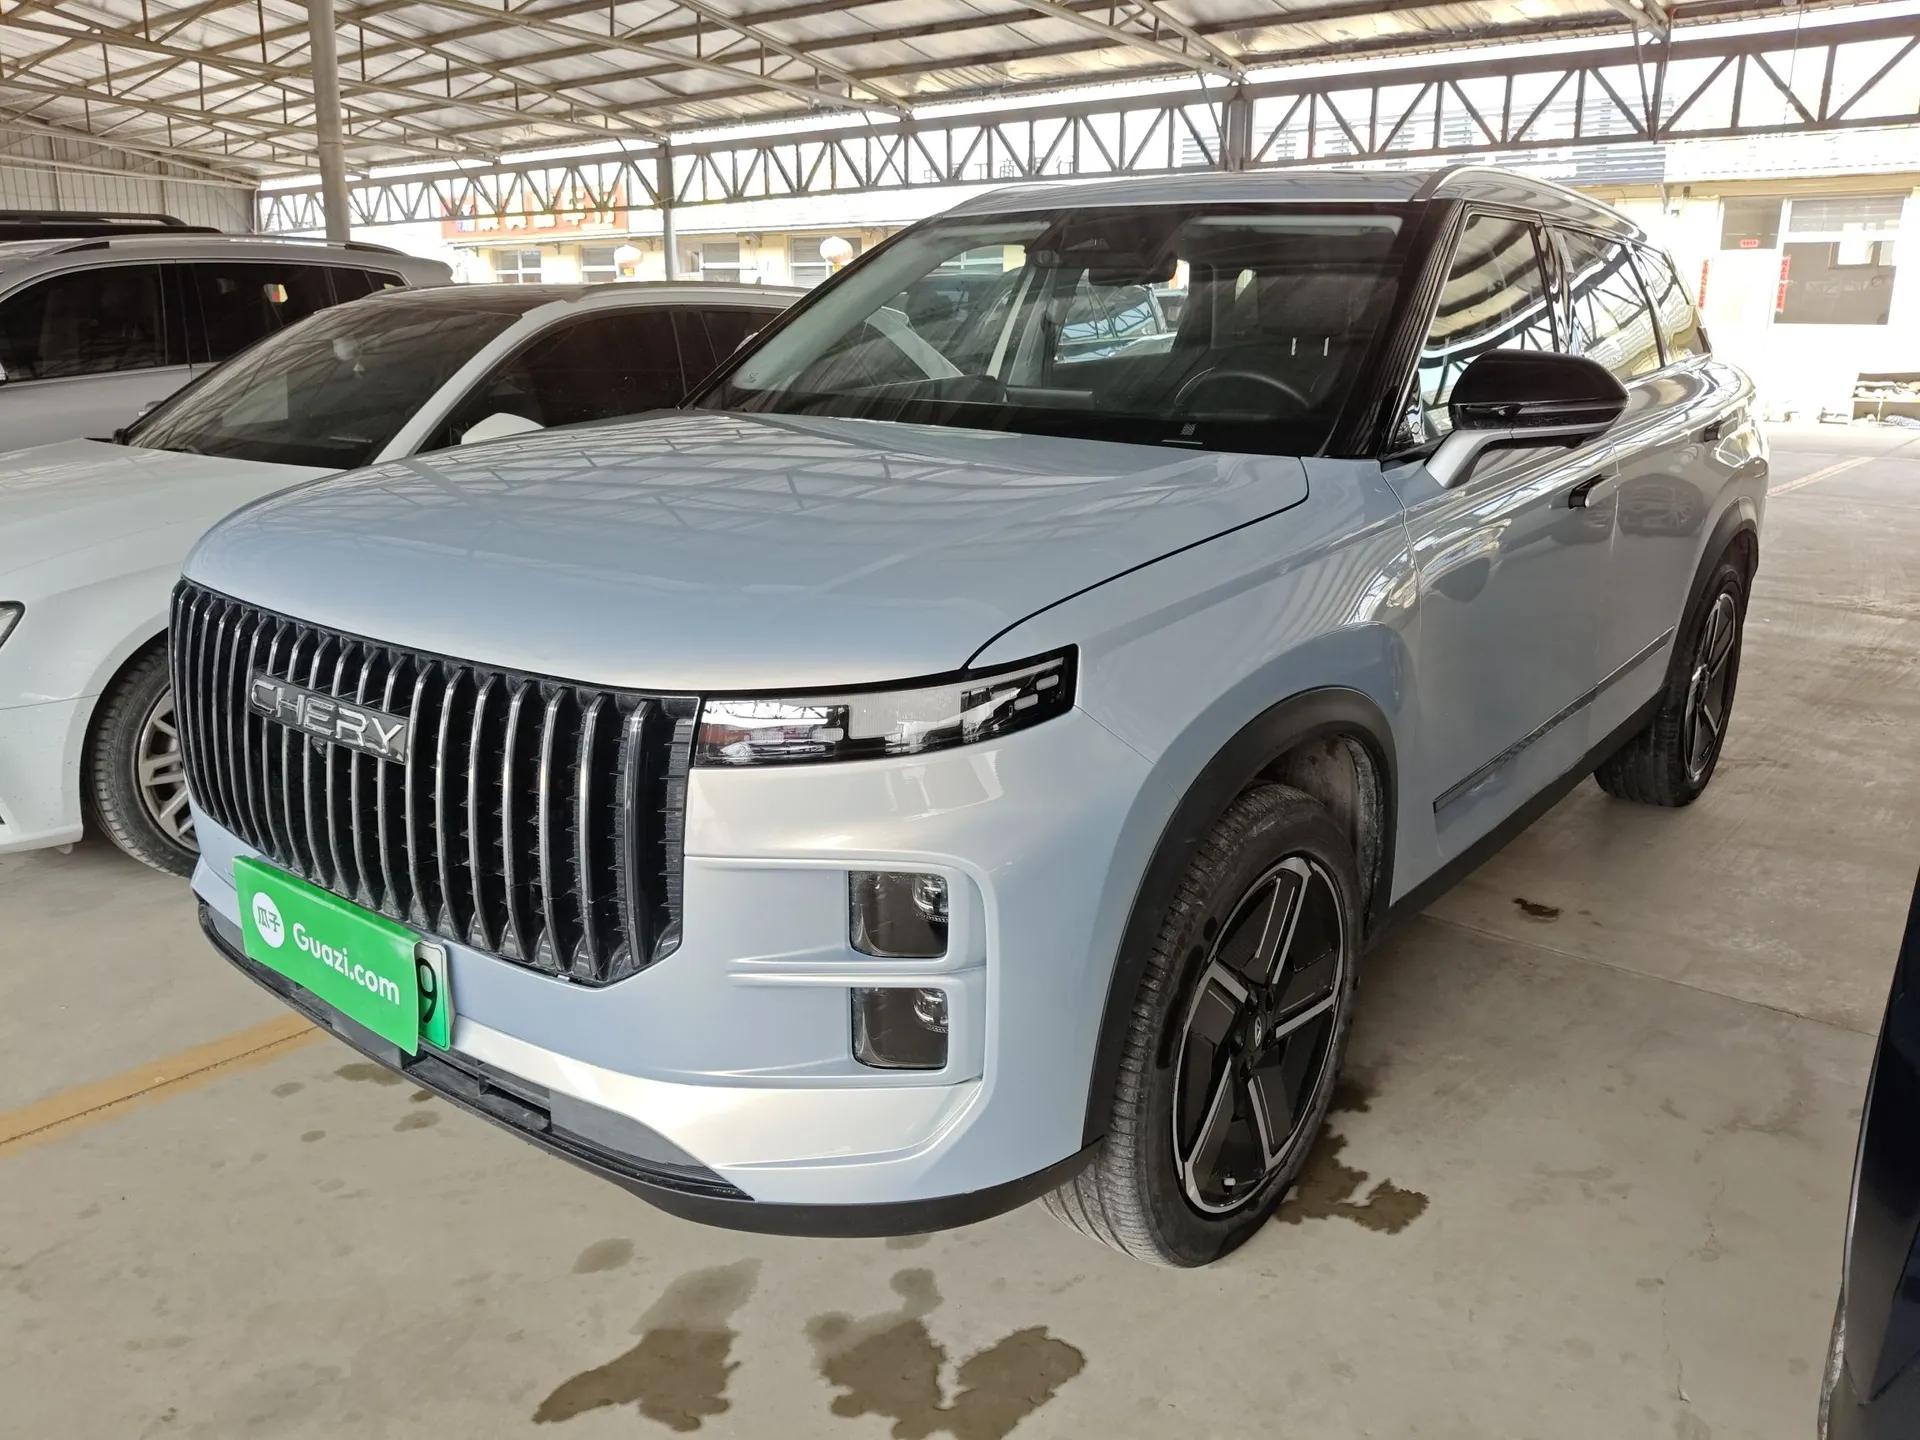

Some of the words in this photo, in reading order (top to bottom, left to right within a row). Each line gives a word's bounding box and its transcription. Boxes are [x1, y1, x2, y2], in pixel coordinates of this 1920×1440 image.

[251, 679, 405, 754] CHERY
[256, 906, 281, 933] 瓜子
[293, 922, 400, 1005] Guazi.com
